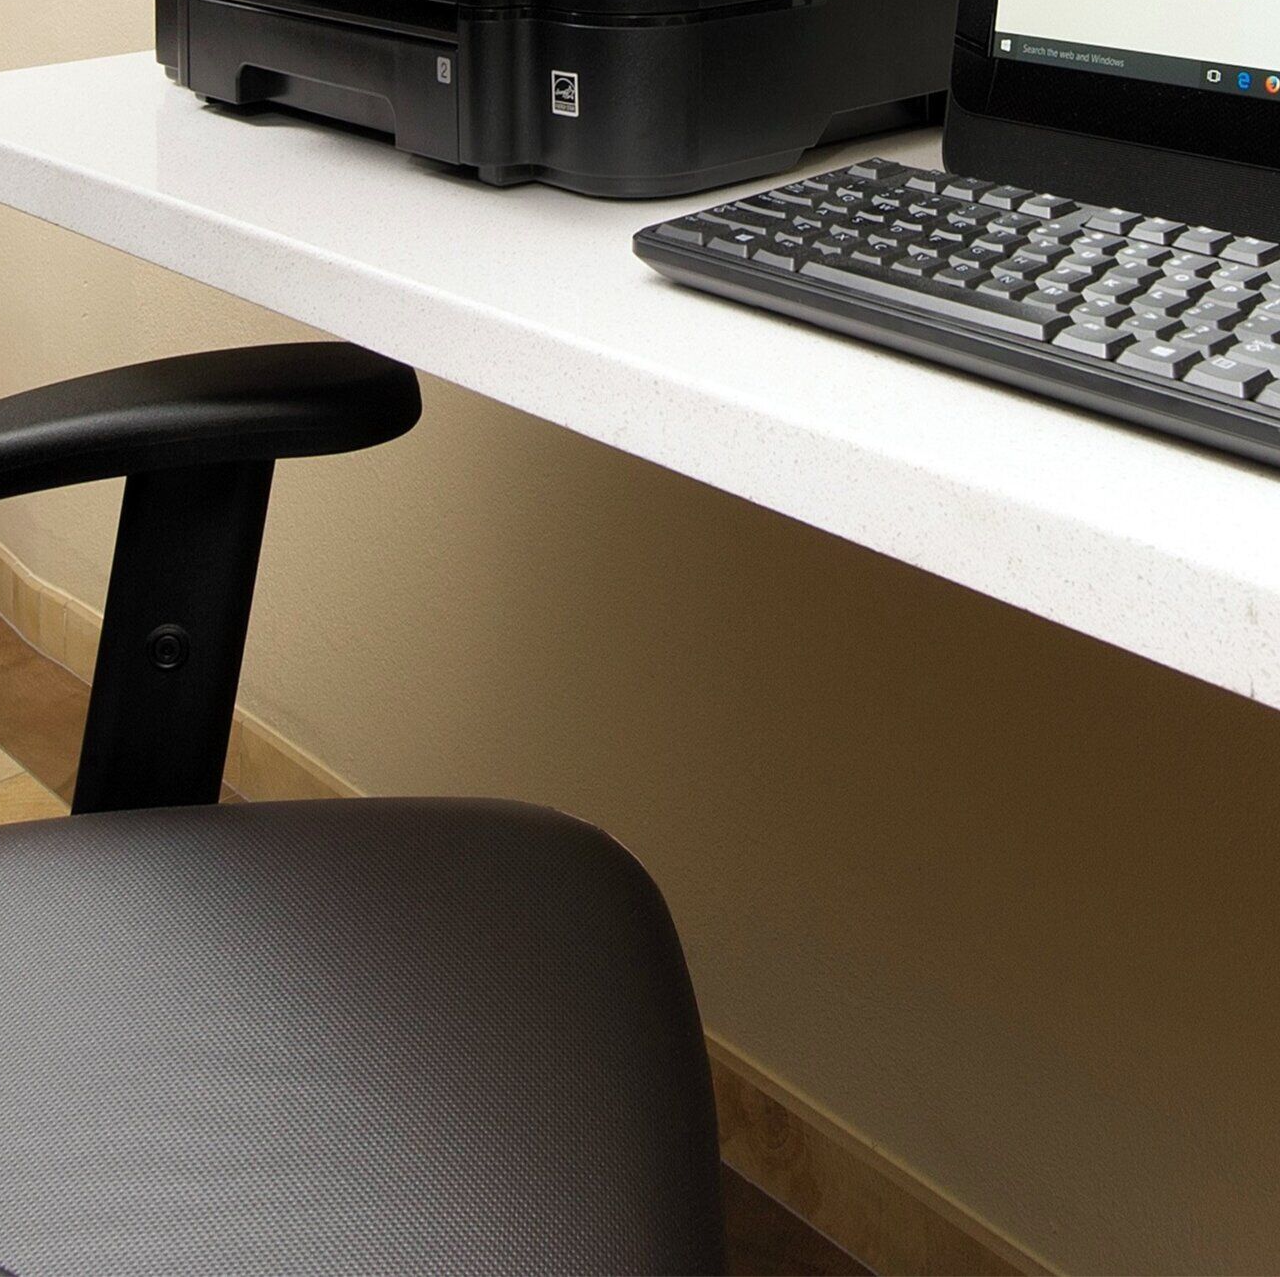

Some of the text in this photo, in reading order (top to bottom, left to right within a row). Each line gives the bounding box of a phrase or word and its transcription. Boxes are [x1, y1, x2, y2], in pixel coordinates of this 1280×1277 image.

[1022, 43, 1125, 68] Search the web and Windows
